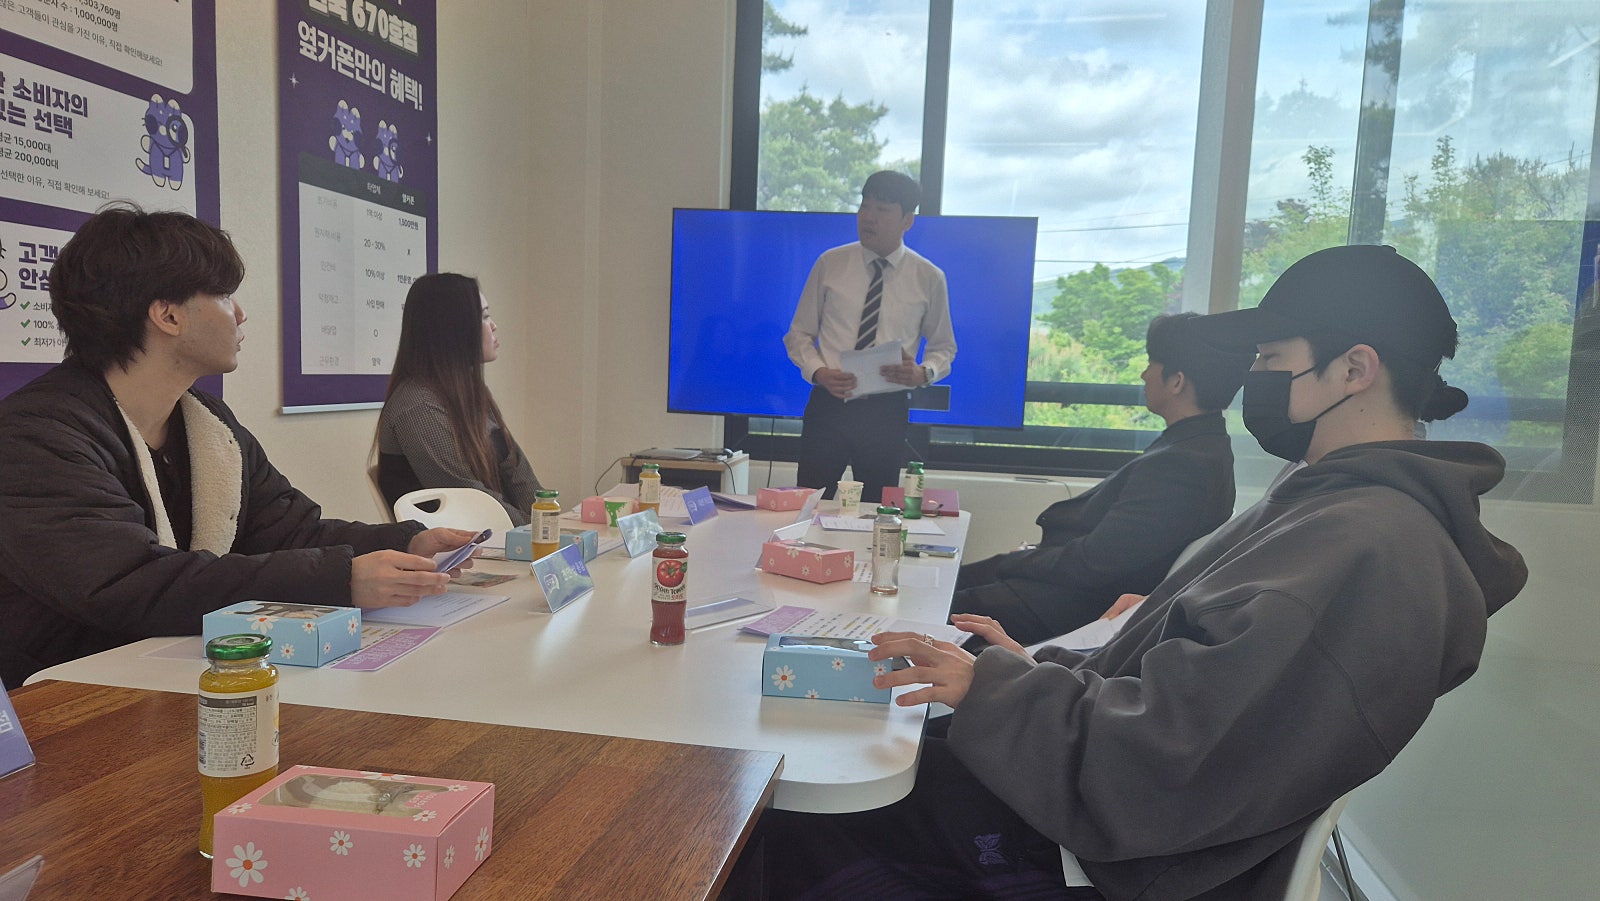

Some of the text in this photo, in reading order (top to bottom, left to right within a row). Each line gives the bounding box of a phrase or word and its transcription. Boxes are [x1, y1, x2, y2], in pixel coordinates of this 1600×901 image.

[18, 5, 50, 25] 고객들이
[52, 17, 74, 34] 관심을
[76, 27, 91, 40] 가진
[74, 7, 118, 32] 1,000,000명
[352, 0, 418, 54] 670호점
[297, 20, 423, 111] 옆커폰만의 혜택!
[12, 77, 88, 118] 소비자의
[33, 108, 73, 139] 선택
[0, 131, 52, 154] 균 15,000대
[14, 151, 59, 170] 200,000대
[18, 241, 59, 265] 고객
[33, 320, 55, 330] 100%
[33, 337, 56, 348] 최저가
